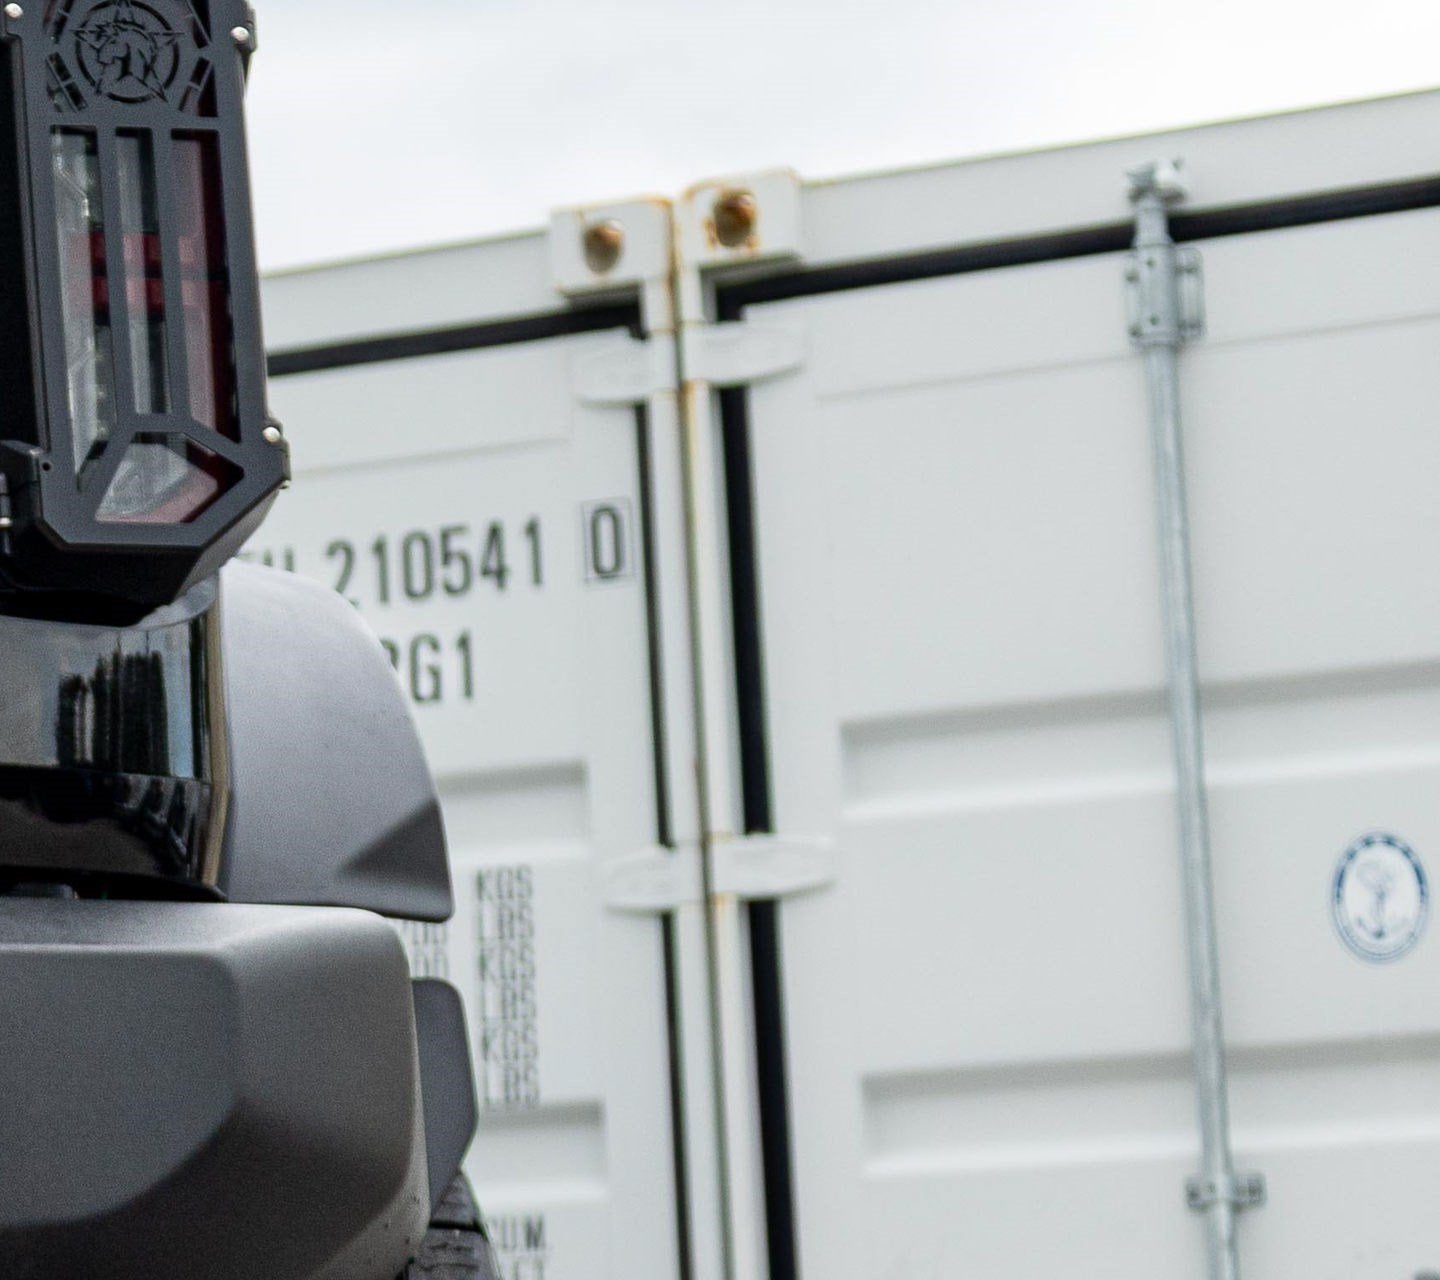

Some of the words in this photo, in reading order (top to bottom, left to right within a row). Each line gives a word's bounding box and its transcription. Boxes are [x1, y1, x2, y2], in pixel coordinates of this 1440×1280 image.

[325, 516, 545, 608] 210541
[590, 504, 626, 581] 0
[379, 629, 476, 705] G1
